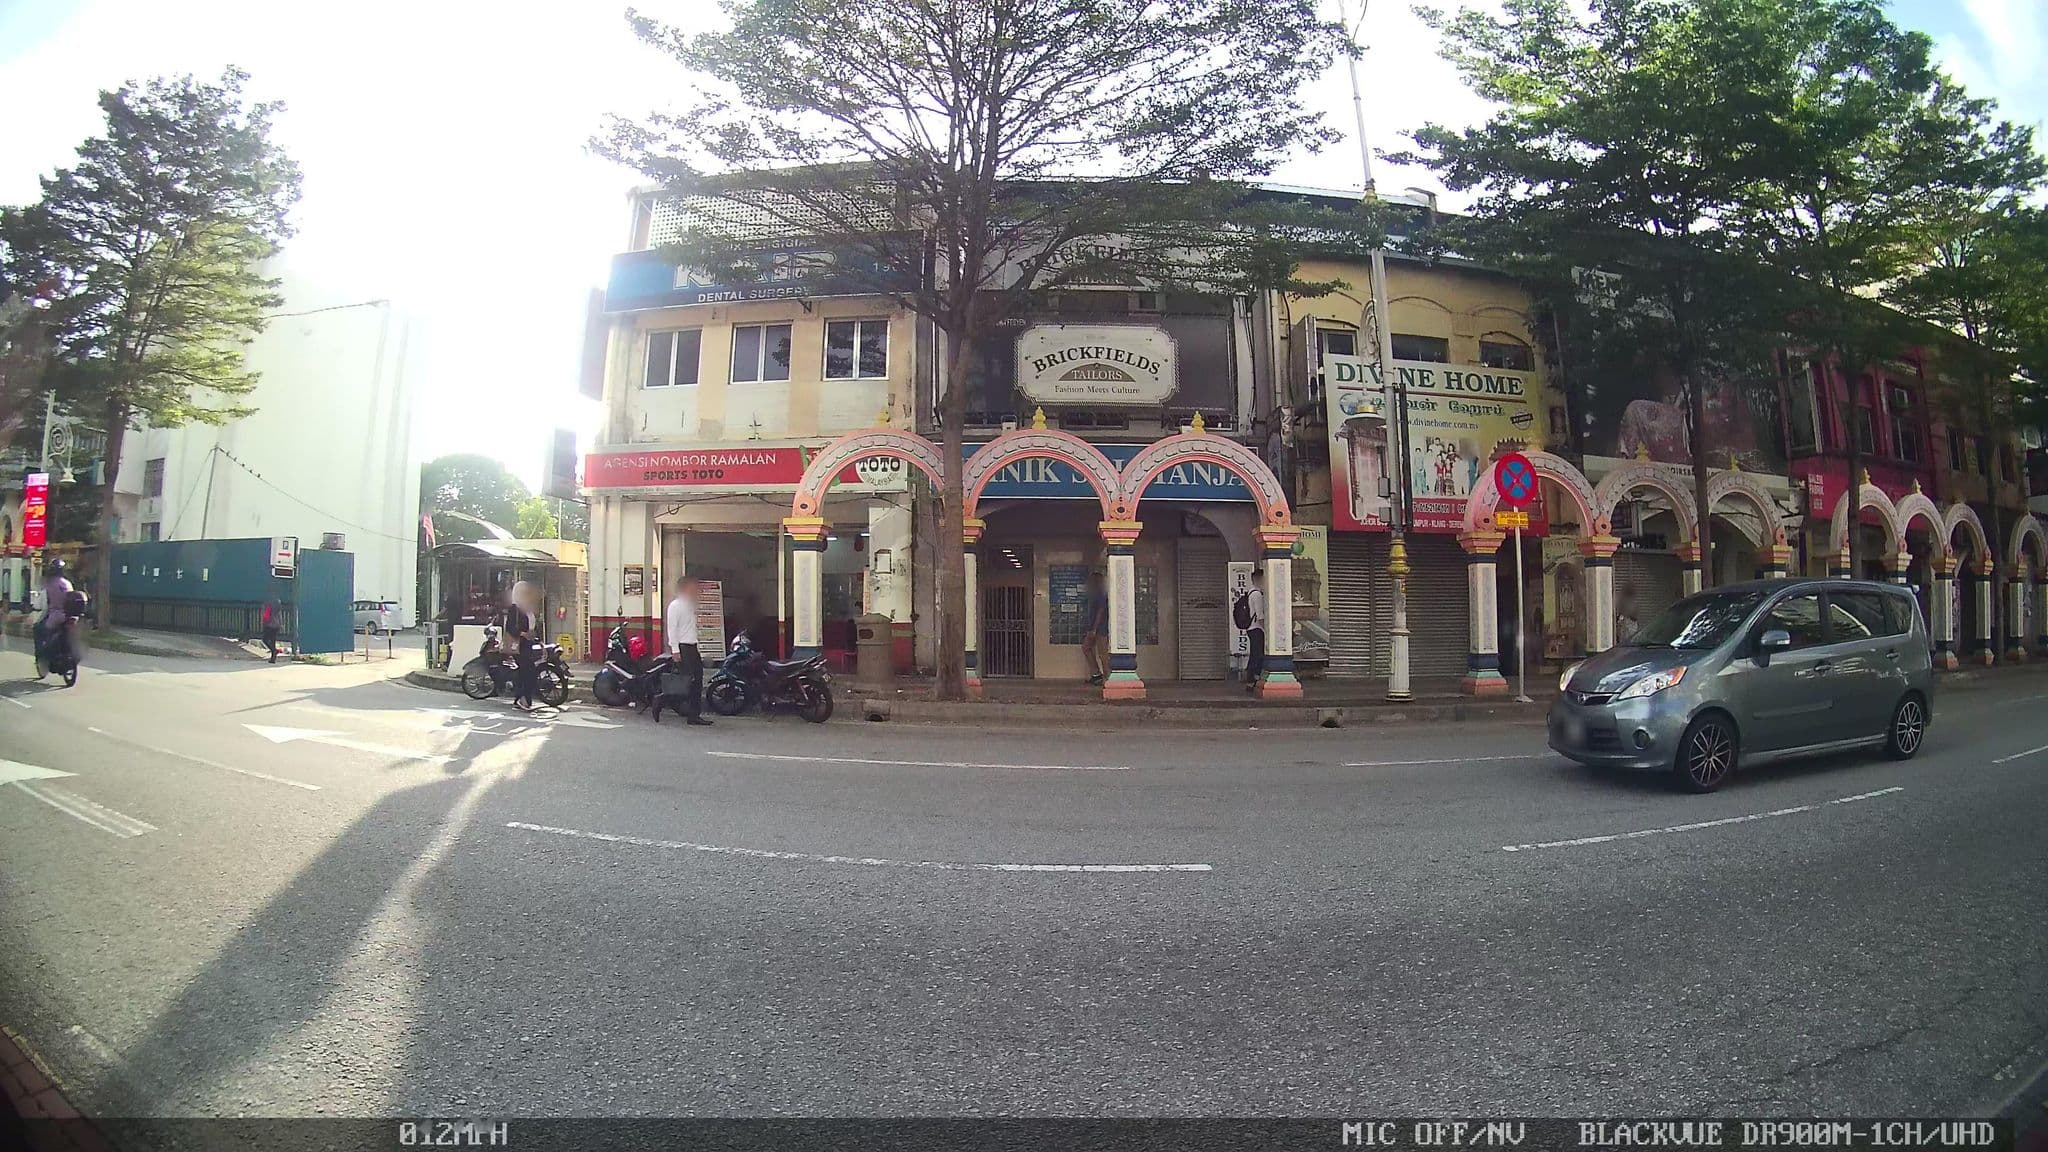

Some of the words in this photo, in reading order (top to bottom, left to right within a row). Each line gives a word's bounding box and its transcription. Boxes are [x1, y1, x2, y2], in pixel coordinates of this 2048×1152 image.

[698, 290, 745, 303] DENTAL
[1032, 345, 1161, 376] BRICKFIELDS
[1072, 369, 1123, 381] TAILORS
[1055, 385, 1084, 394] Fashion
[1087, 385, 1109, 394] Meets
[1111, 385, 1140, 395] Culture
[1444, 370, 1525, 397] HOME
[605, 457, 648, 469] AGENSI
[651, 456, 706, 466] NOMBOR
[711, 453, 777, 465] RAMALAN
[859, 457, 901, 472] TOTO
[643, 471, 688, 480] SPORTS
[692, 469, 724, 479] TOTO
